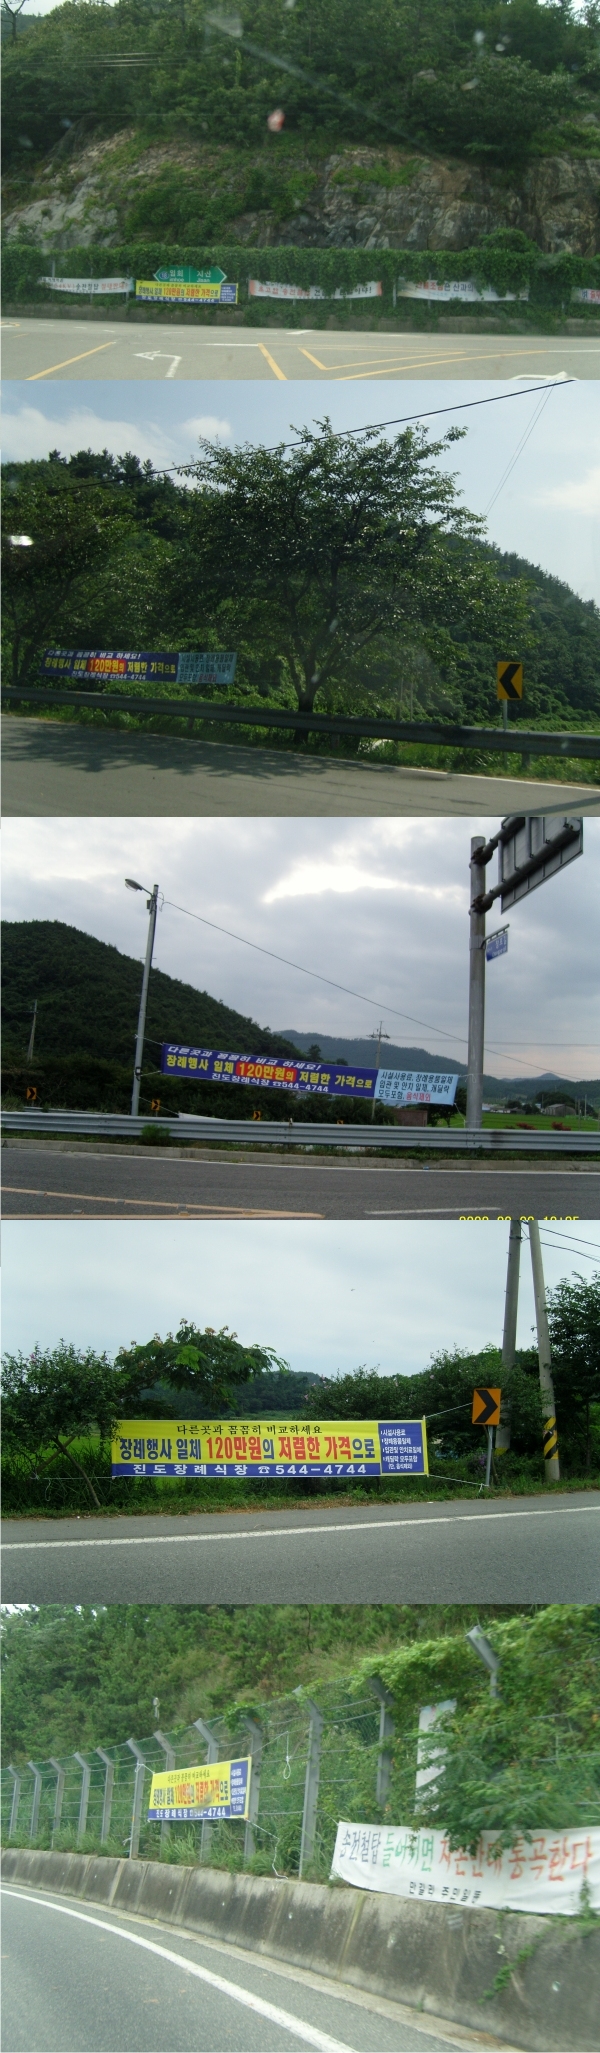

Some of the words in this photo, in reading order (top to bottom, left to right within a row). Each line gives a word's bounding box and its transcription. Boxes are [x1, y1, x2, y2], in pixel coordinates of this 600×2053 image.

[169, 269, 184, 277] 임회
[196, 270, 211, 278] 지산
[163, 287, 185, 297] 120만원의
[185, 288, 200, 297] 저렴한
[201, 288, 219, 297] 가격으로
[453, 282, 474, 292] 산과의
[116, 652, 141, 660] 하세요!
[44, 657, 71, 669] 장례행사
[73, 659, 87, 670] 일체
[89, 659, 125, 673] 120만원의
[127, 661, 147, 673] 저렴한
[150, 662, 176, 674] 가격으로
[71, 670, 108, 679] 진도장례식장
[167, 1046, 213, 1057] 다른곳과
[216, 1052, 251, 1063] 꼼꼼히
[255, 1057, 279, 1065] 비교
[282, 1060, 322, 1071] 하세요!
[166, 1054, 209, 1071] 장례행사
[213, 1060, 234, 1074] 일체
[239, 1063, 294, 1081] 120만원의
[299, 1071, 331, 1085] 저렴한
[335, 1074, 373, 1089] 가격으로
[211, 1072, 270, 1086] 진도장례식장
[415, 1074, 453, 1084] 장례용품일체
[379, 1080, 392, 1089] 입관
[393, 1081, 400, 1090] 및
[401, 1082, 414, 1091] 안치
[406, 1092, 431, 1102] 음식제외
[177, 1425, 224, 1435] 다른곳과
[228, 1425, 262, 1435] 꼼꼼히
[267, 1425, 322, 1435] 비교하세요
[119, 1438, 172, 1460] 장례행사
[176, 1438, 201, 1460] 일체
[206, 1436, 275, 1460] 120만원의
[278, 1436, 321, 1461] 저렴한
[324, 1436, 375, 1460] 가격으로
[133, 1464, 248, 1475] 진도장례식장
[339, 1828, 381, 1864] 송전철탑
[508, 1836, 593, 1881] 통곡한다
